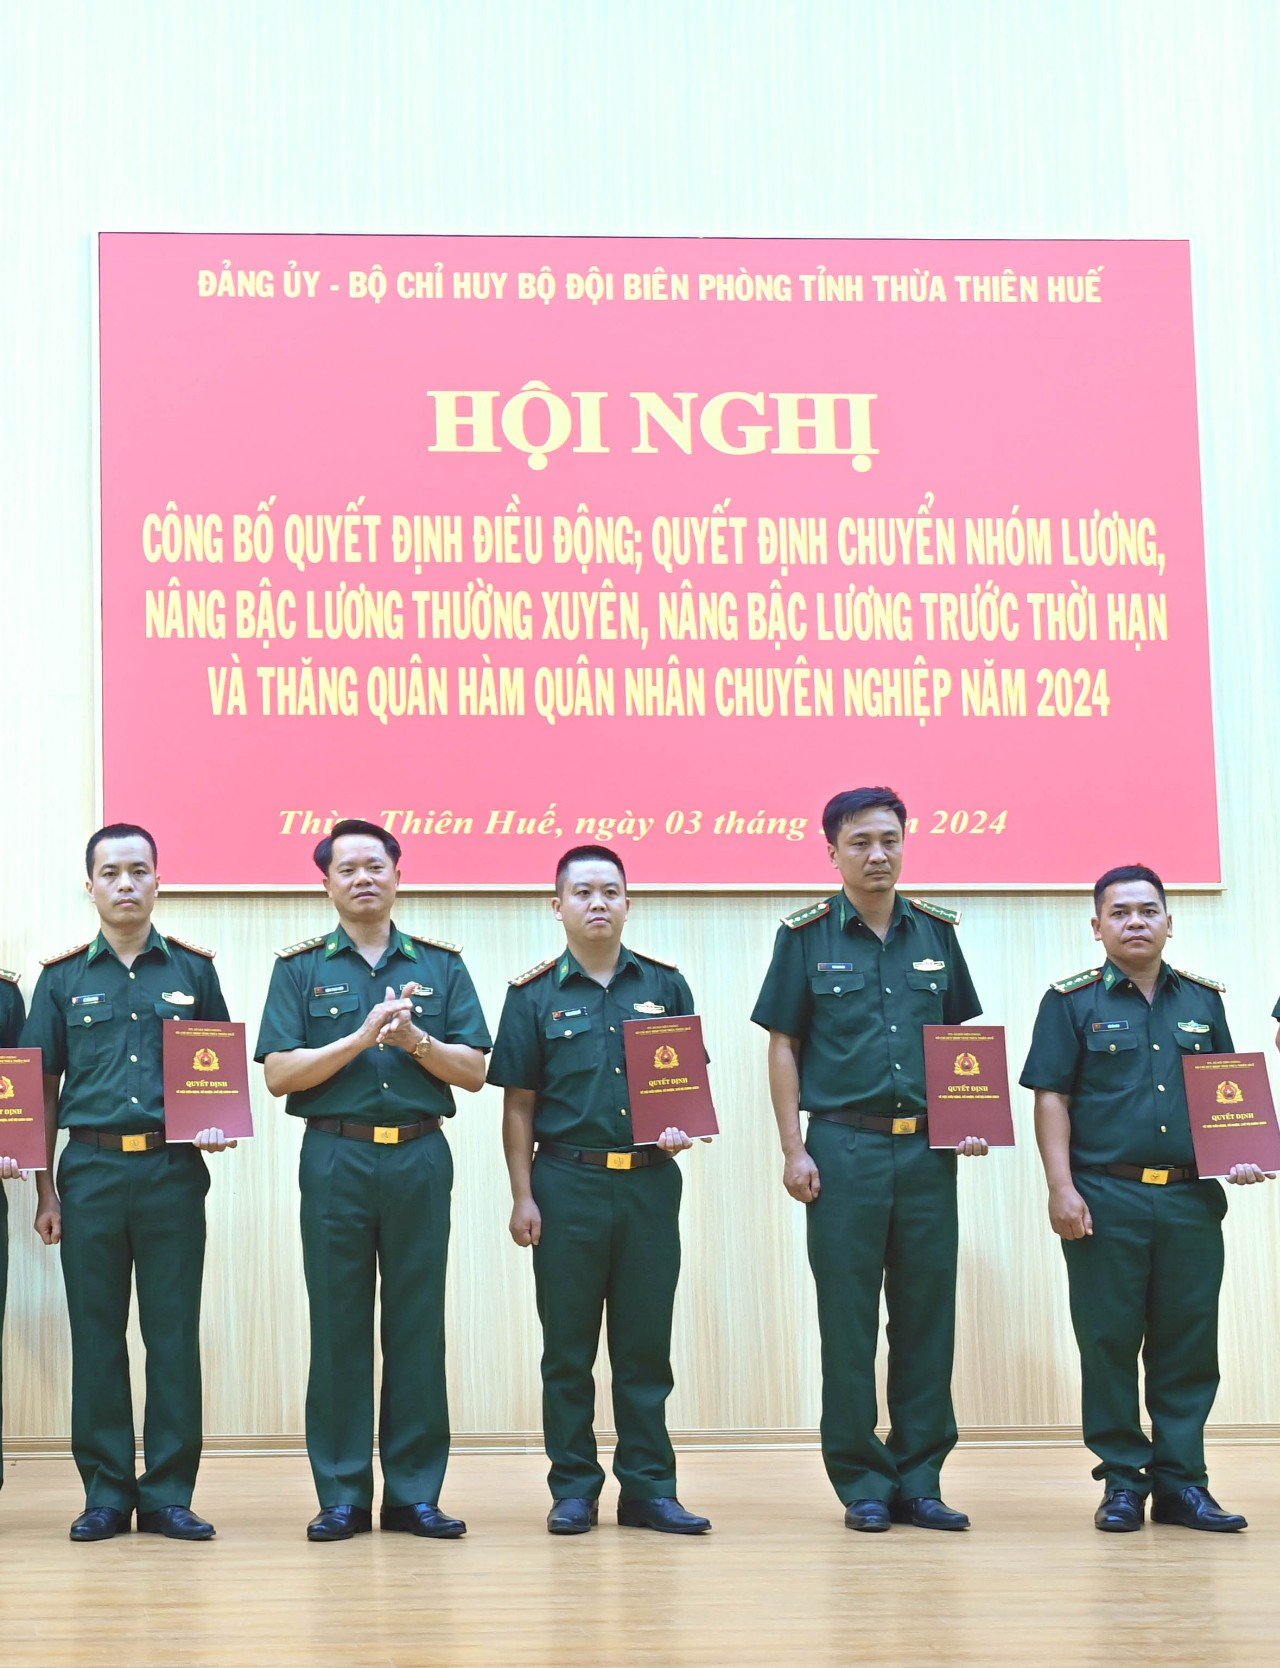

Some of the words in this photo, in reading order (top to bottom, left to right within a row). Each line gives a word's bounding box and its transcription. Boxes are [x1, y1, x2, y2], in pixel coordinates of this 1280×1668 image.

[197, 260, 275, 298] ĐẢNG
[284, 261, 320, 298] ỦY
[349, 264, 387, 304] BỘ
[398, 262, 444, 299] CHỈ
[454, 271, 508, 299] HUY
[519, 266, 557, 304] BỘ
[565, 266, 614, 305] ĐỘI
[625, 268, 690, 301] BIÊN
[700, 269, 792, 301] PHÒNG
[800, 266, 864, 302] TỈNH
[873, 269, 948, 302] THỪA
[956, 269, 1039, 303] THIÊN
[1048, 266, 1103, 303] HUẾ
[428, 380, 610, 471] HỘI
[630, 391, 880, 473] NGHỊ
[143, 501, 224, 564] CÔNG
[233, 496, 276, 563] BỐ
[285, 496, 382, 572] QUYẾT
[392, 515, 463, 575] ĐỊNH
[473, 494, 543, 564] ĐIỀU
[553, 503, 643, 576] ĐỘNG;
[652, 498, 748, 573] QUYẾT
[758, 517, 828, 576] ĐỊNH
[838, 492, 957, 566] CHUYỂN
[966, 505, 1053, 567] NHÓM
[1063, 509, 1167, 575] LƯƠNG,
[145, 577, 226, 640] NÂNG
[235, 577, 296, 649] BẬC
[306, 582, 404, 640] LƯƠNG
[412, 578, 533, 640] THƯỜNG
[542, 579, 649, 650] XUYÊN,
[659, 579, 739, 641] NÂNG
[748, 579, 808, 650] BẬC
[817, 582, 913, 641] LƯƠNG
[920, 580, 1020, 642] TRƯỚC
[1027, 581, 1098, 642] THỜI
[1108, 592, 1168, 651] HẠN
[209, 653, 247, 715] VÀ
[257, 657, 358, 716] THĂNG
[367, 653, 448, 725] QUÂN
[459, 654, 525, 716] HÀM
[536, 654, 615, 725] QUÂN
[625, 654, 706, 716] NHÂN
[716, 655, 834, 717] CHUYÊN
[844, 656, 953, 726] NGHIỆP
[961, 659, 1028, 717] NĂM
[1037, 668, 1111, 717] 2024
[381, 809, 473, 834] Thiên
[485, 803, 564, 840] Huế,
[575, 810, 654, 841] ngày
[665, 810, 703, 834] 03
[714, 810, 808, 842] tháng
[930, 809, 1008, 834] 2024
